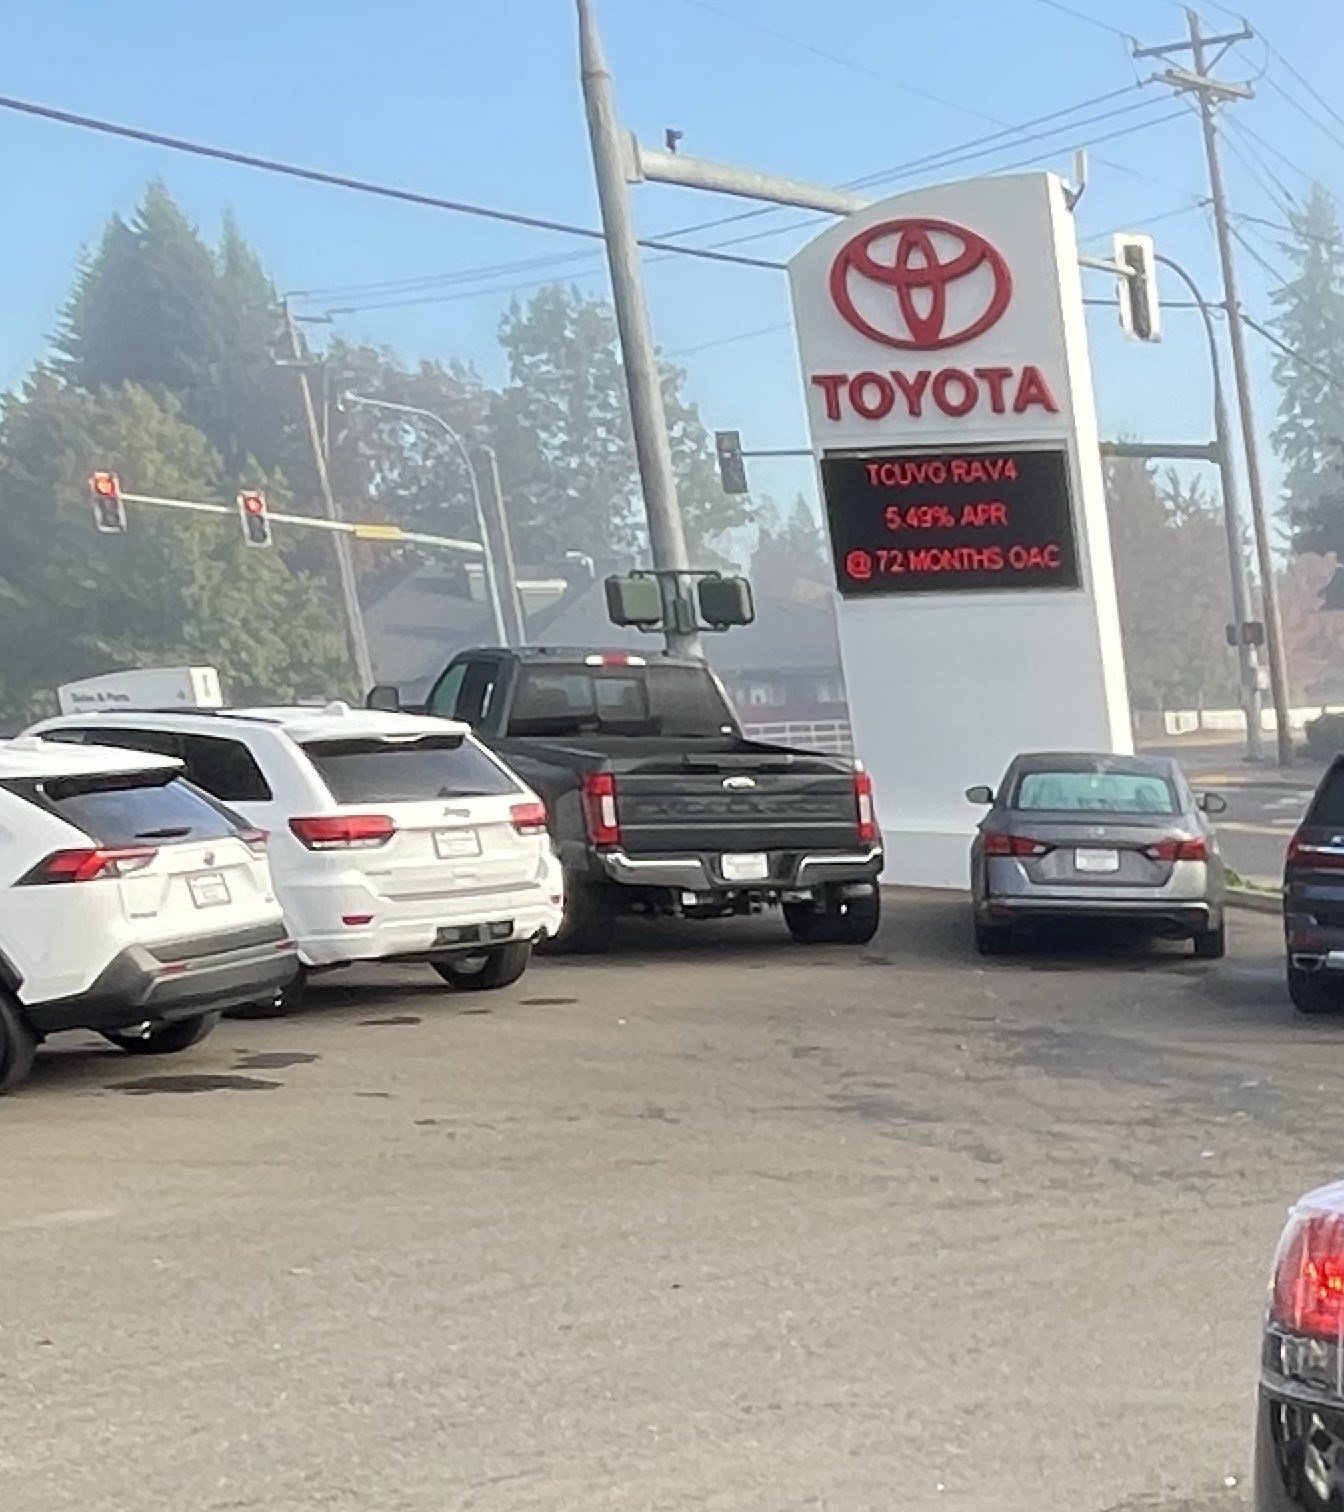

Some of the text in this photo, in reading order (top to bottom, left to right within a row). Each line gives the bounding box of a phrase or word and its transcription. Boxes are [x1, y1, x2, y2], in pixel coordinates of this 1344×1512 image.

[812, 365, 1059, 420] TOYOTA
[950, 458, 1018, 483] RAV4
[885, 503, 1008, 529] 5.49% APR
[846, 543, 1060, 579] @ 72 MONTHS OAC
